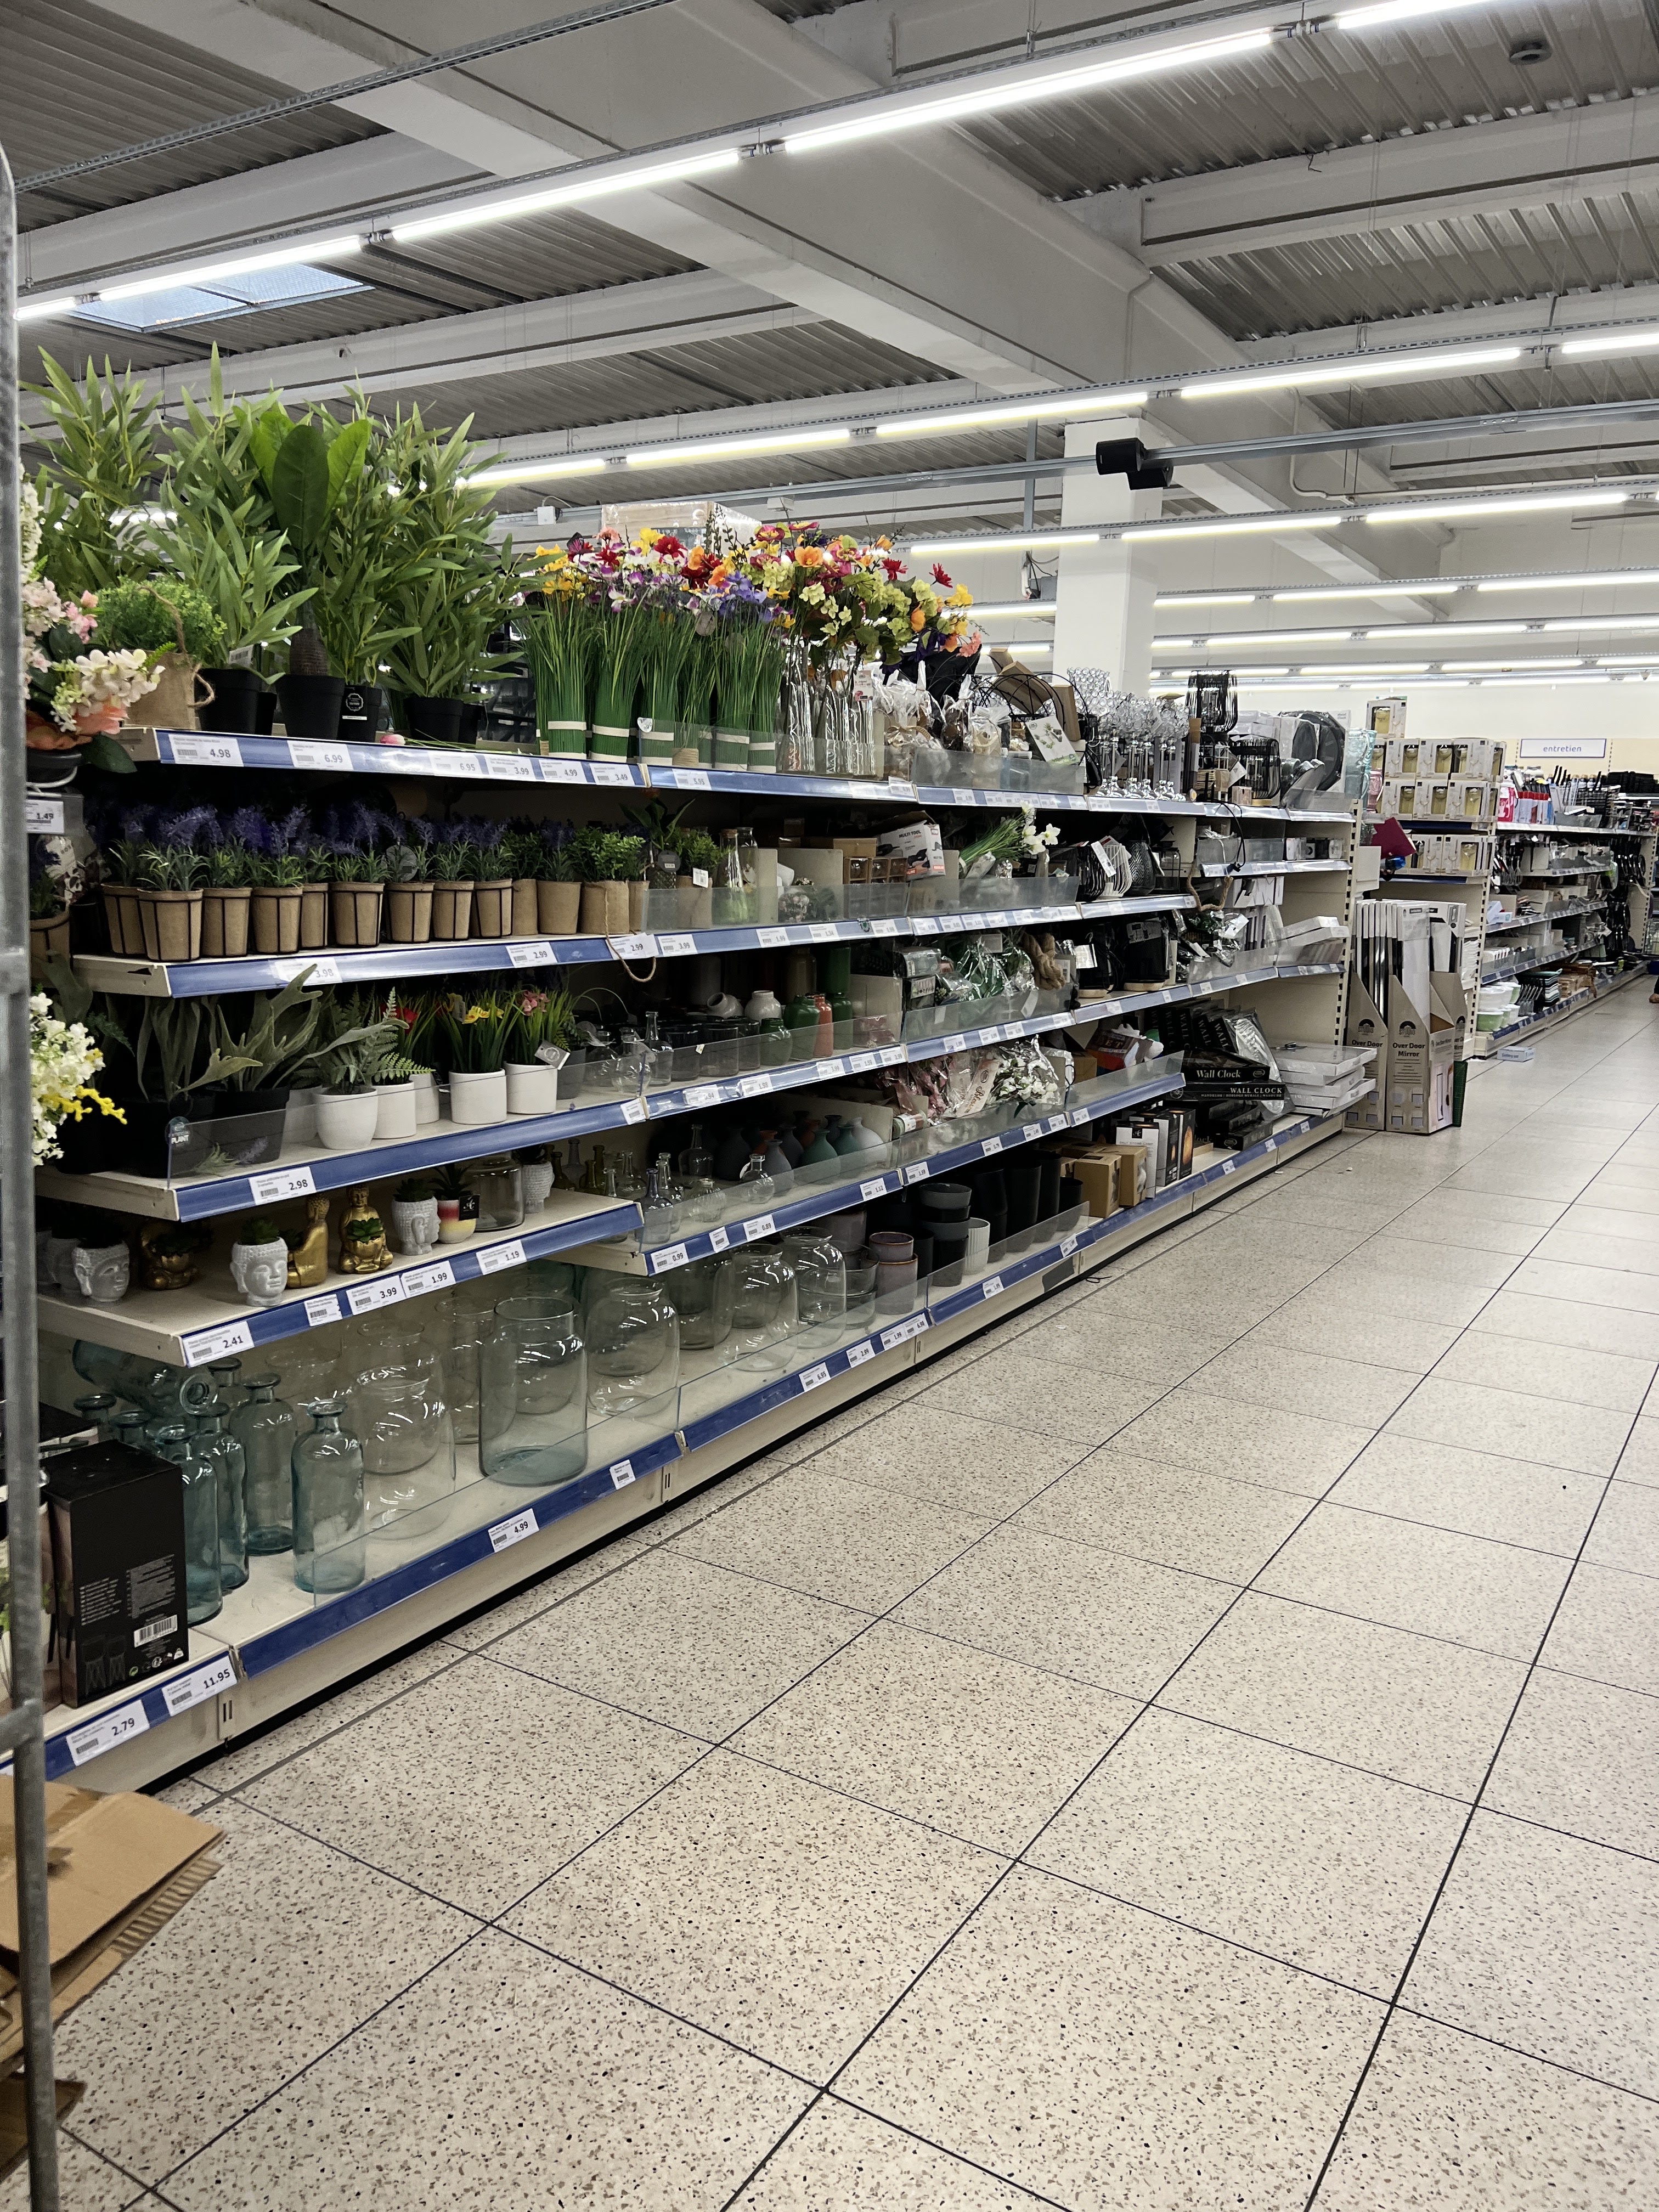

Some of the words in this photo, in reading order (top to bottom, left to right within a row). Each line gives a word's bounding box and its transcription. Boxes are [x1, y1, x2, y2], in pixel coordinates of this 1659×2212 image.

[210, 749, 230, 758] 4.98
[325, 754, 343, 763] 6.99
[533, 951, 548, 959] 2.99
[316, 969, 334, 978] 3.98
[289, 1179, 308, 1190] 2.98
[505, 1251, 520, 1261] 1.19
[673, 1252, 683, 1261] 0.99
[431, 1272, 448, 1284] 1.99
[380, 1287, 397, 1299] 3.99
[223, 1335, 244, 1349] 2.41
[514, 1521, 528, 1534] 4.99
[203, 1668, 230, 1689] 11.95
[111, 1718, 135, 1736] 2.79
